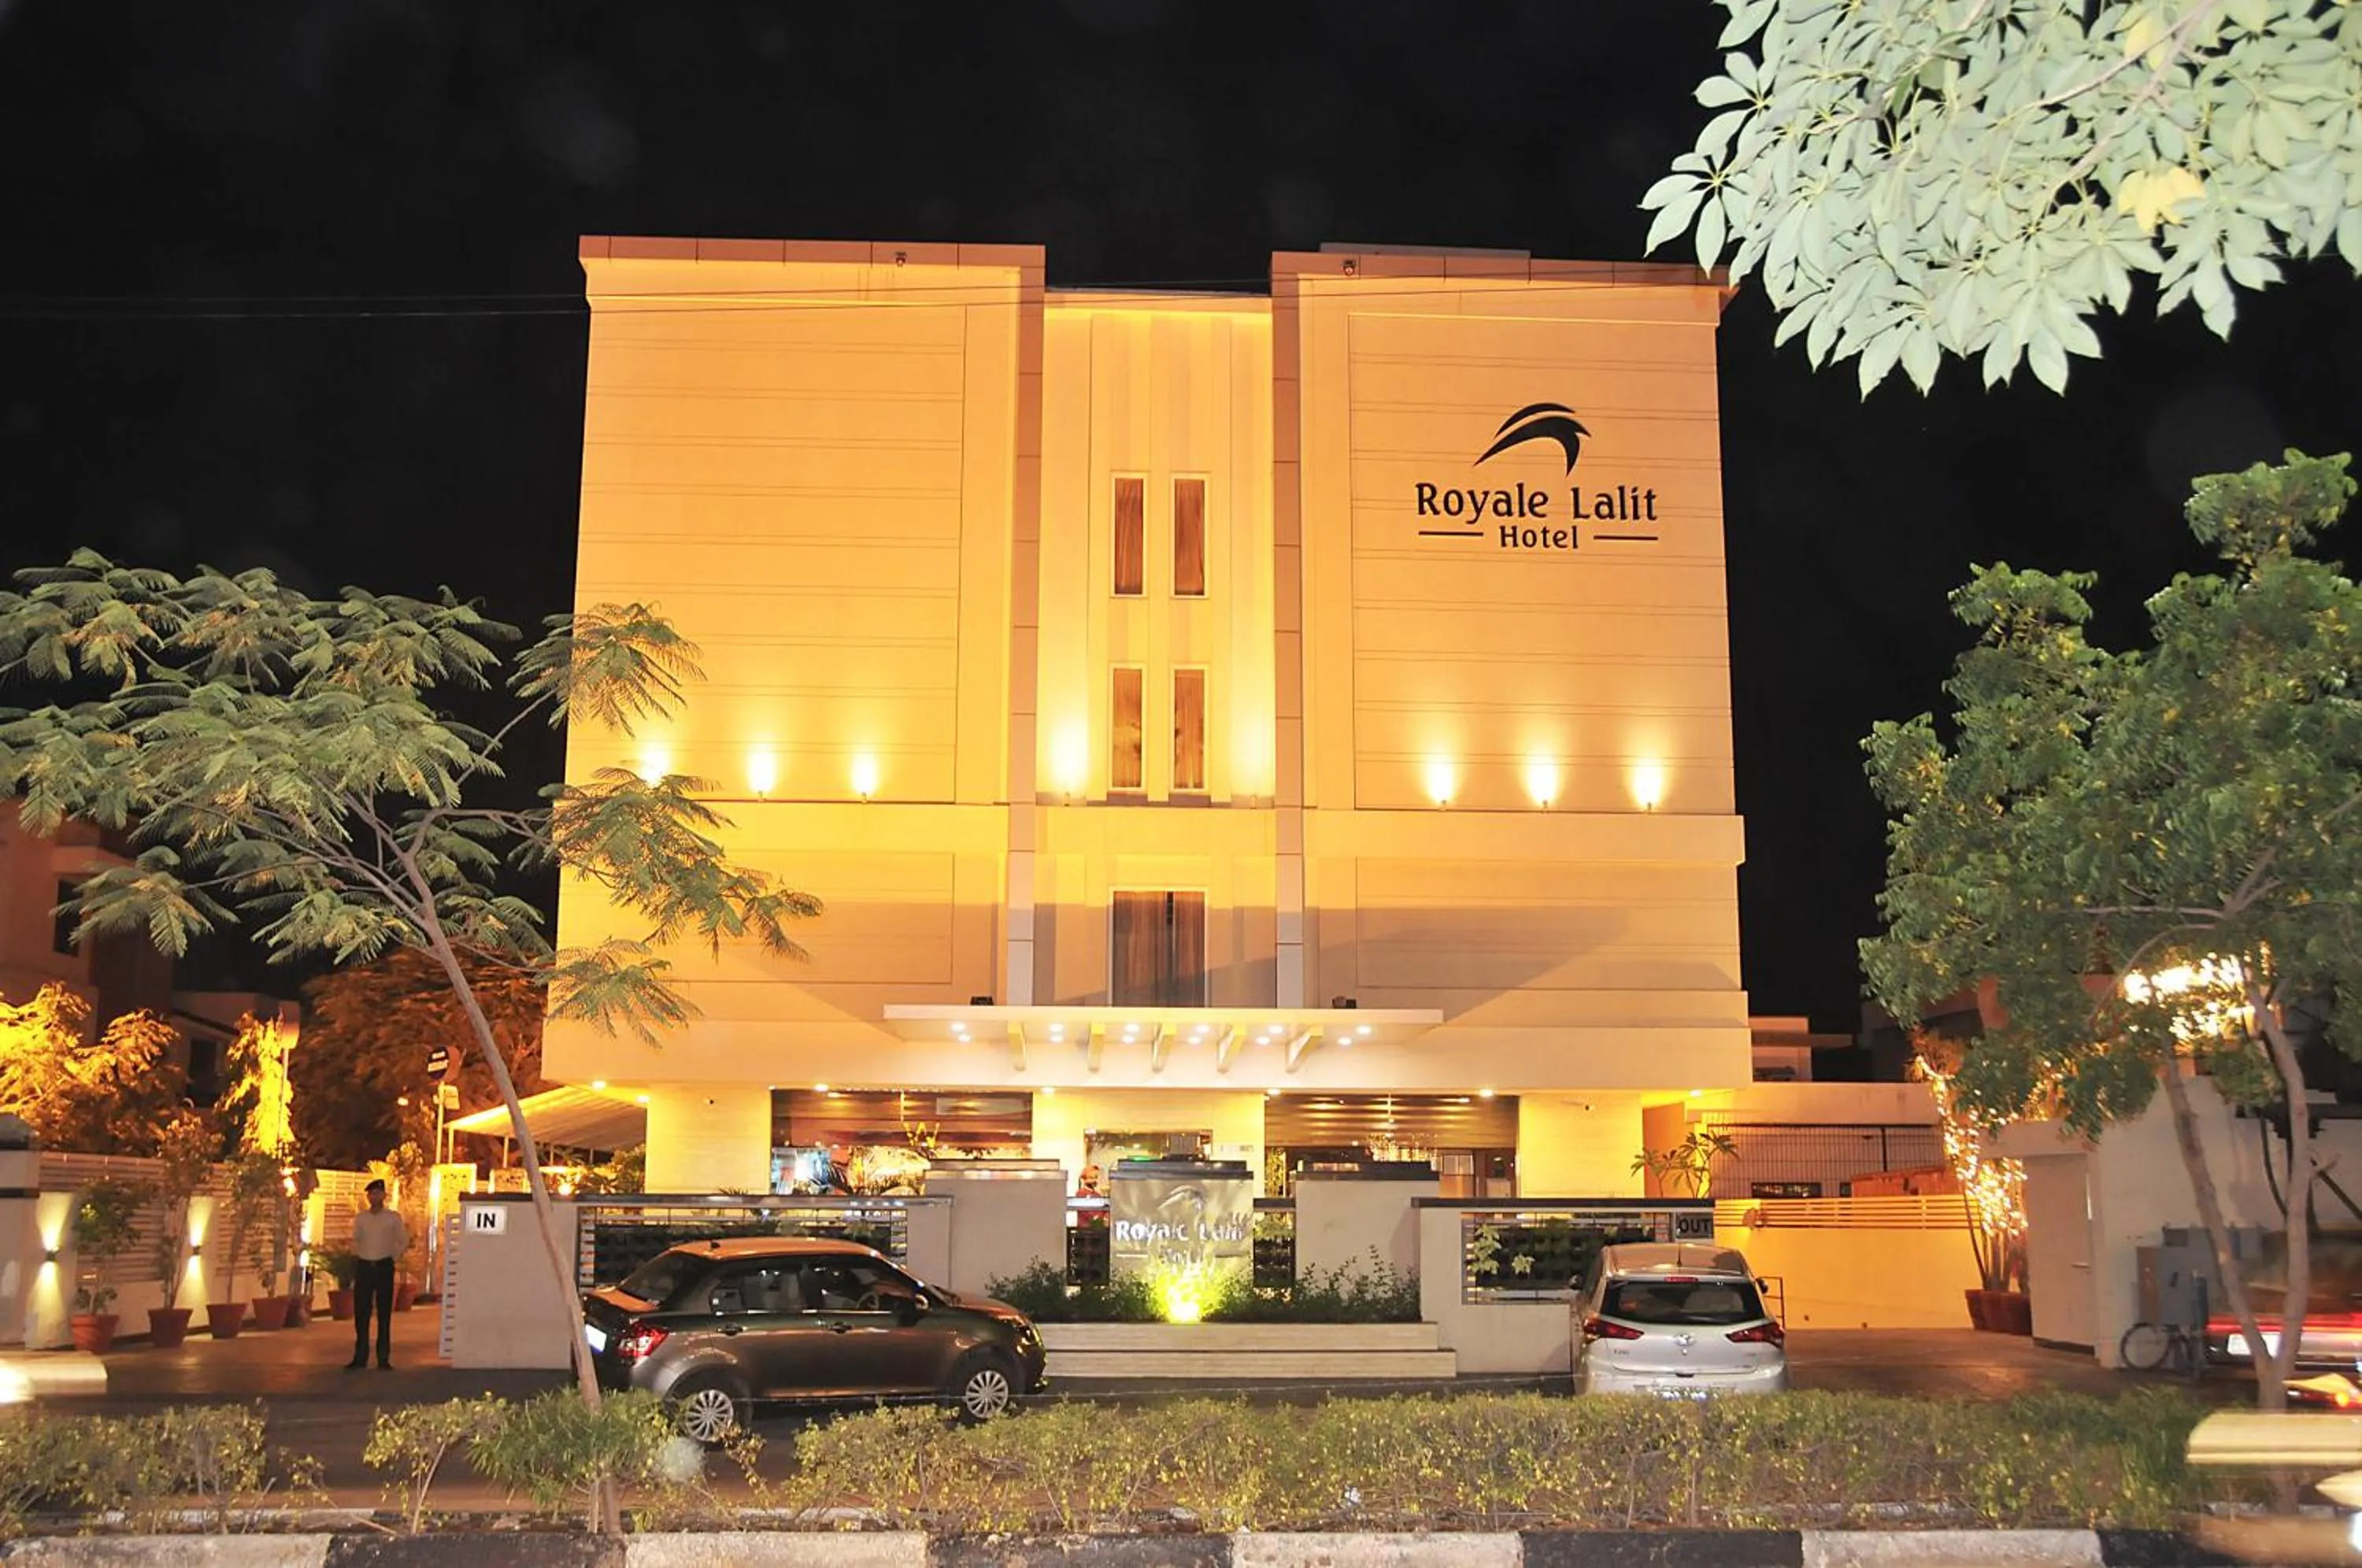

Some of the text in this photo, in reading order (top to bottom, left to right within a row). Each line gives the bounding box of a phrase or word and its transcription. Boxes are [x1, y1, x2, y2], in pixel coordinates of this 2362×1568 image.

[1415, 483, 1659, 525] Royale Lalit
[1499, 525, 1579, 549] Hotel
[476, 1213, 496, 1229] IN
[1679, 1217, 1712, 1233] OUT
